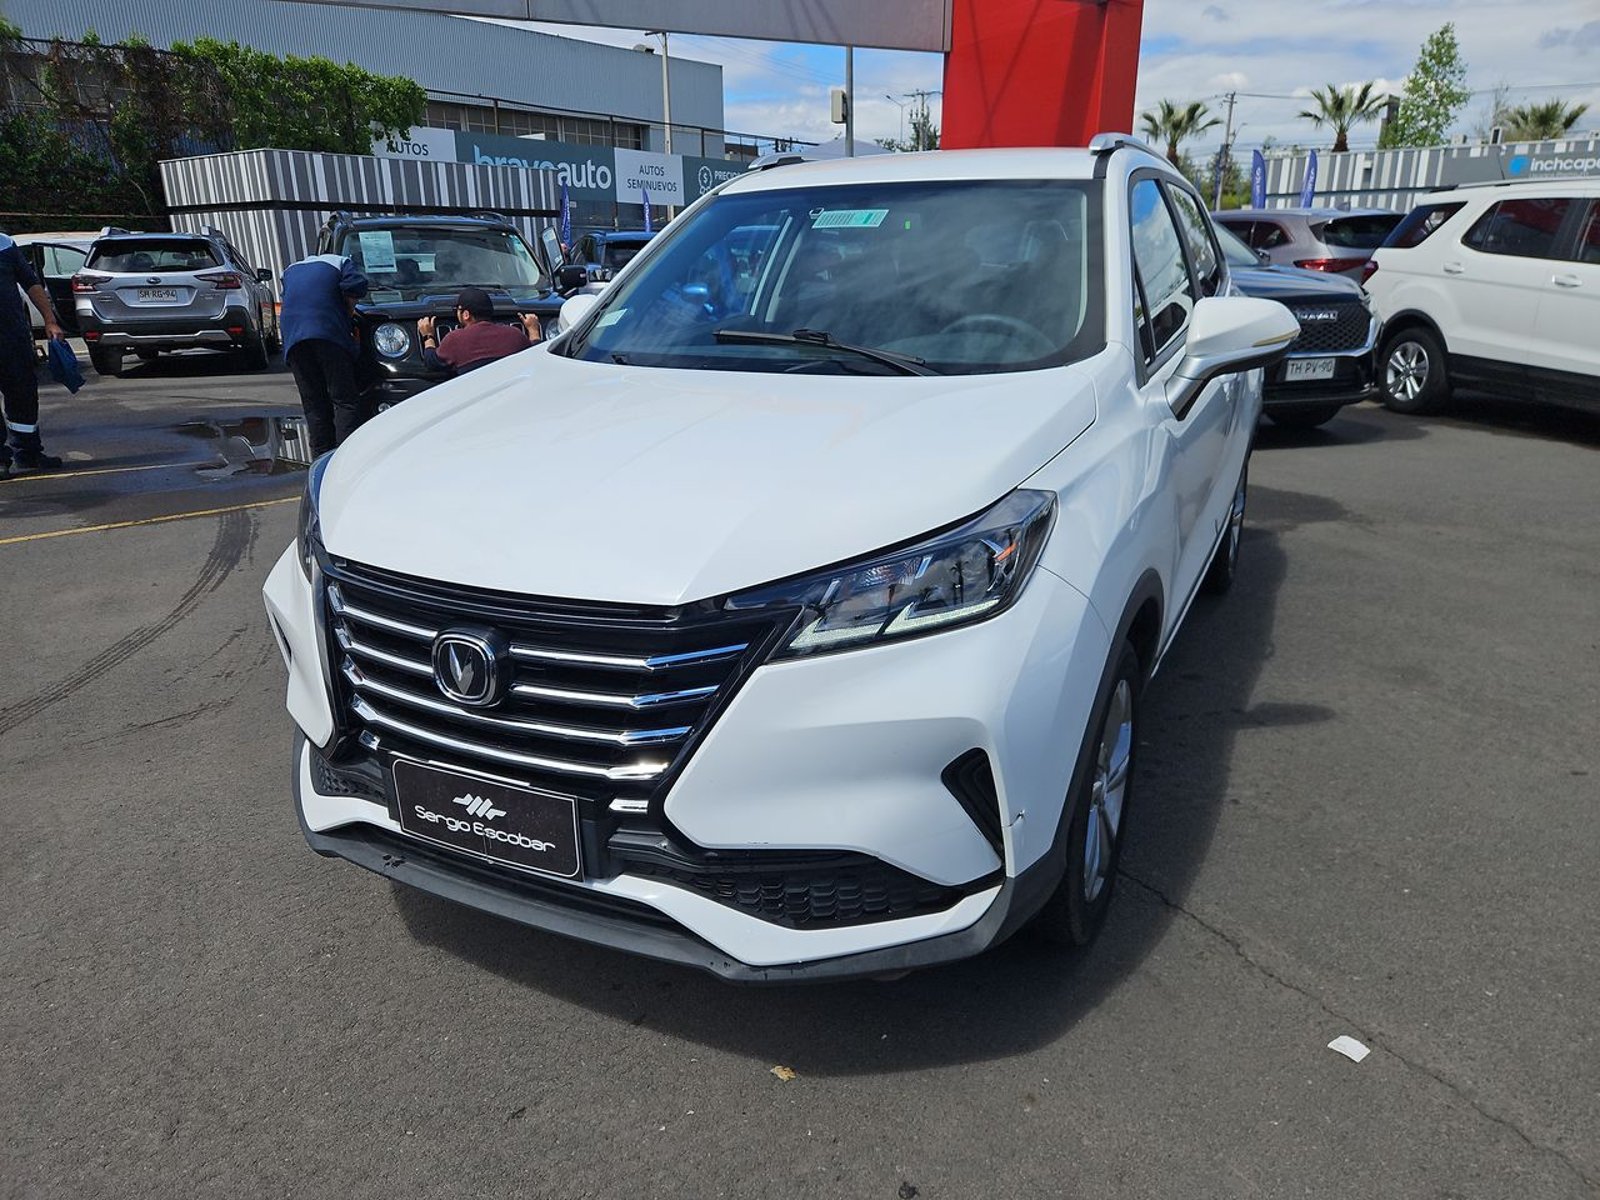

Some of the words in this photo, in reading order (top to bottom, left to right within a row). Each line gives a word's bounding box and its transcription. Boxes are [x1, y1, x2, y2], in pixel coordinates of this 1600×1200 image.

[639, 165, 665, 177] AUTOS
[627, 178, 677, 192] SEMINUEVOS
[473, 822, 556, 852] Escobar
